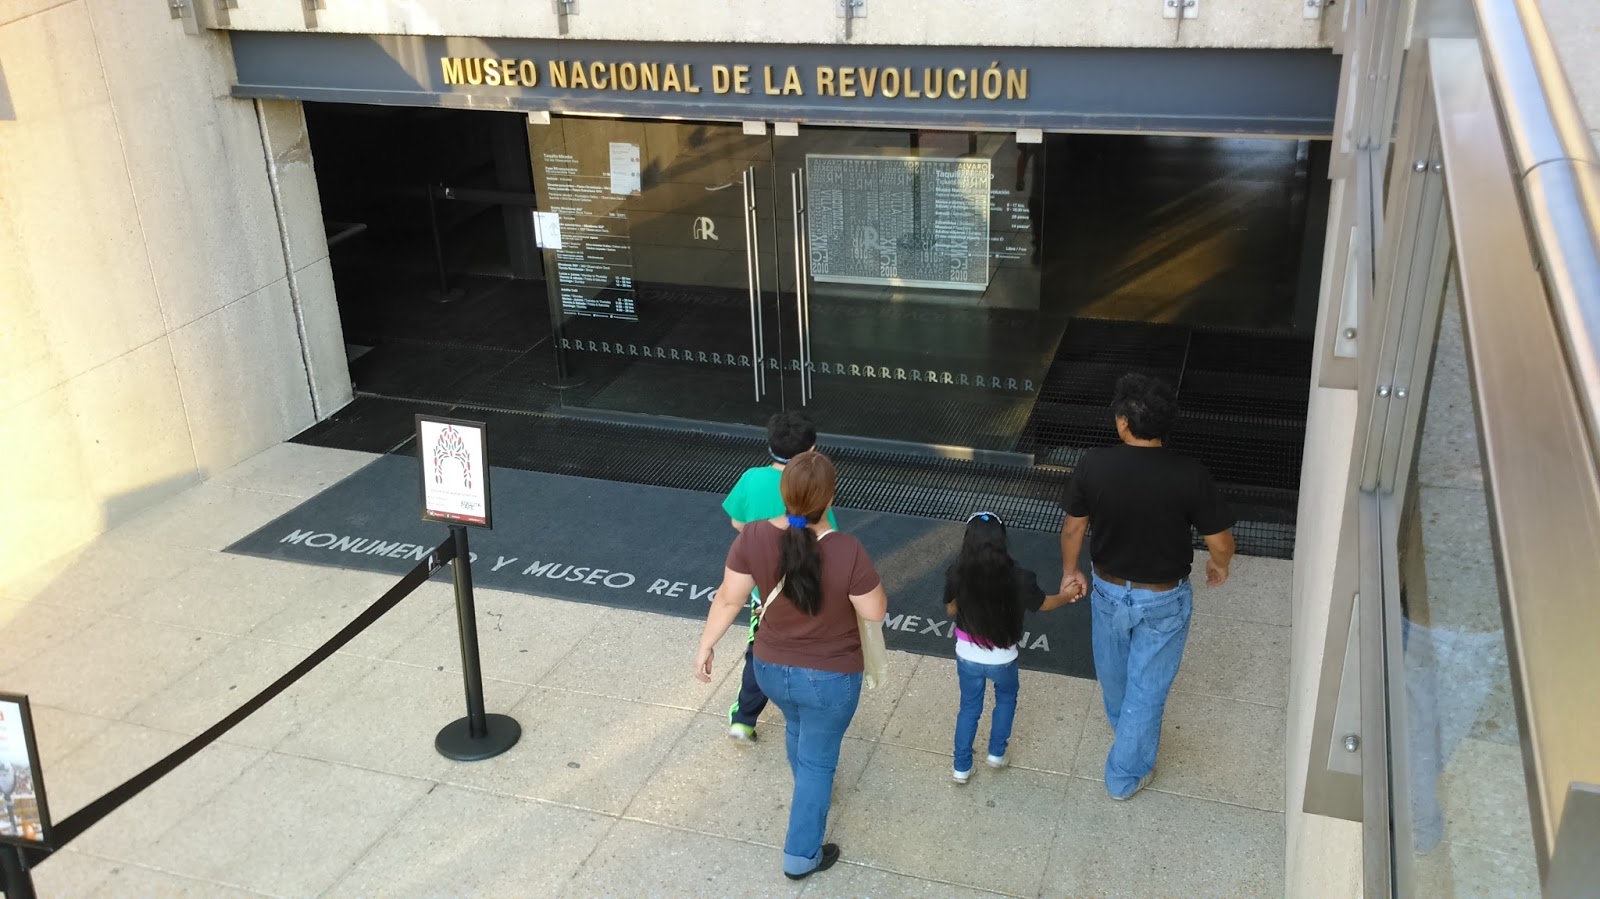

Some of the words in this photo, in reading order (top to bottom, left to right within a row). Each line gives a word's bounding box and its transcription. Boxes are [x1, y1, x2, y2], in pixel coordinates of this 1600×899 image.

[441, 57, 538, 88] MUSEO
[548, 60, 701, 93] NACIONAL
[711, 64, 750, 95] DE
[763, 66, 804, 96] LA
[816, 60, 1028, 100] REVOLUCIÓN
[280, 529, 477, 565] MONUMEN
[491, 556, 518, 572] Y
[522, 561, 635, 588] MUSEO
